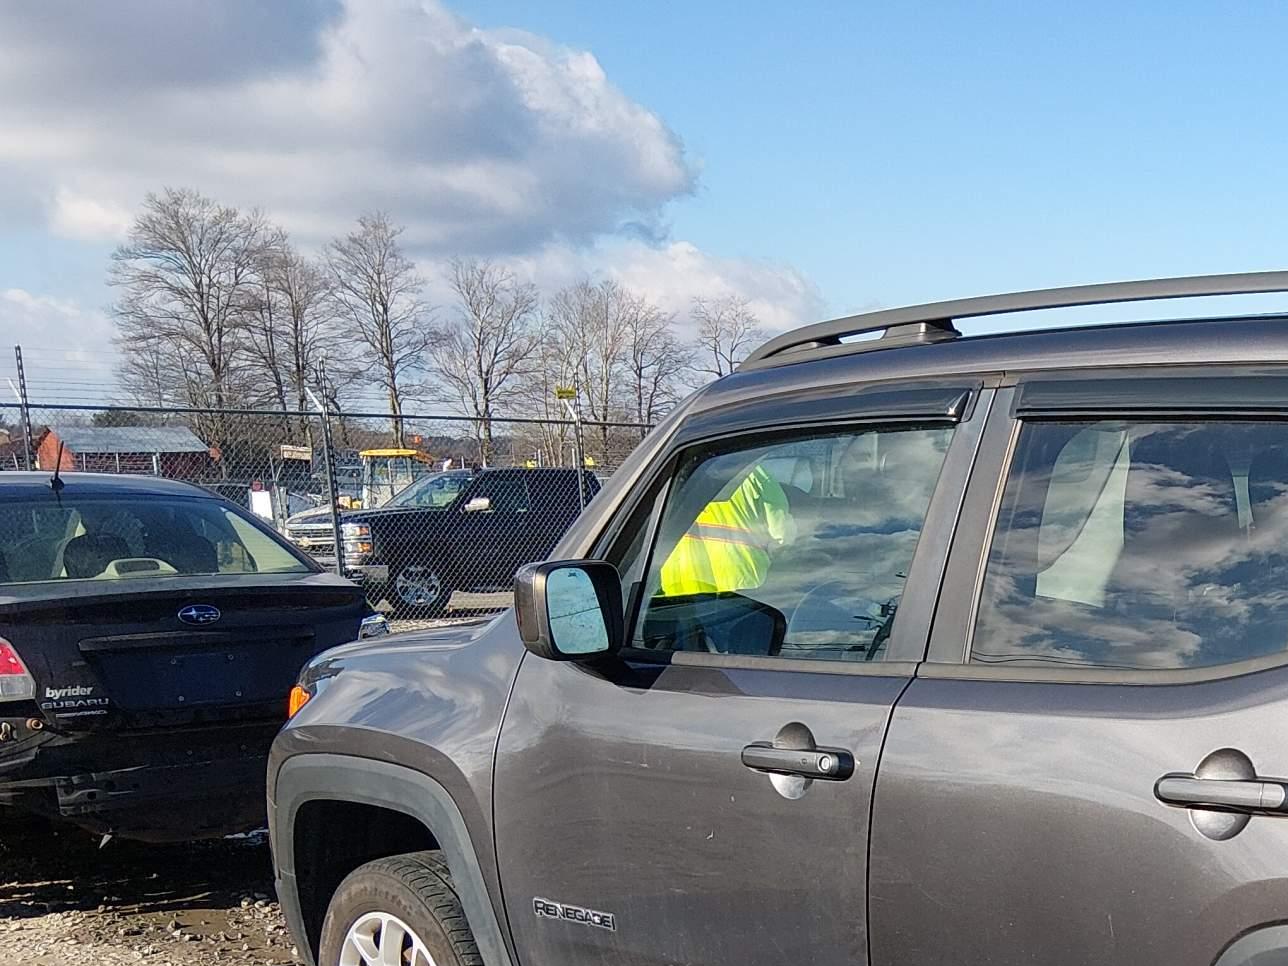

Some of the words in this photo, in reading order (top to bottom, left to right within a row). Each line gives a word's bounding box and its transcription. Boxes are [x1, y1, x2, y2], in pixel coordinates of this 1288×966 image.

[45, 685, 94, 700] byrider
[41, 698, 109, 709] SUBARU
[533, 897, 616, 931] RENEGADE
